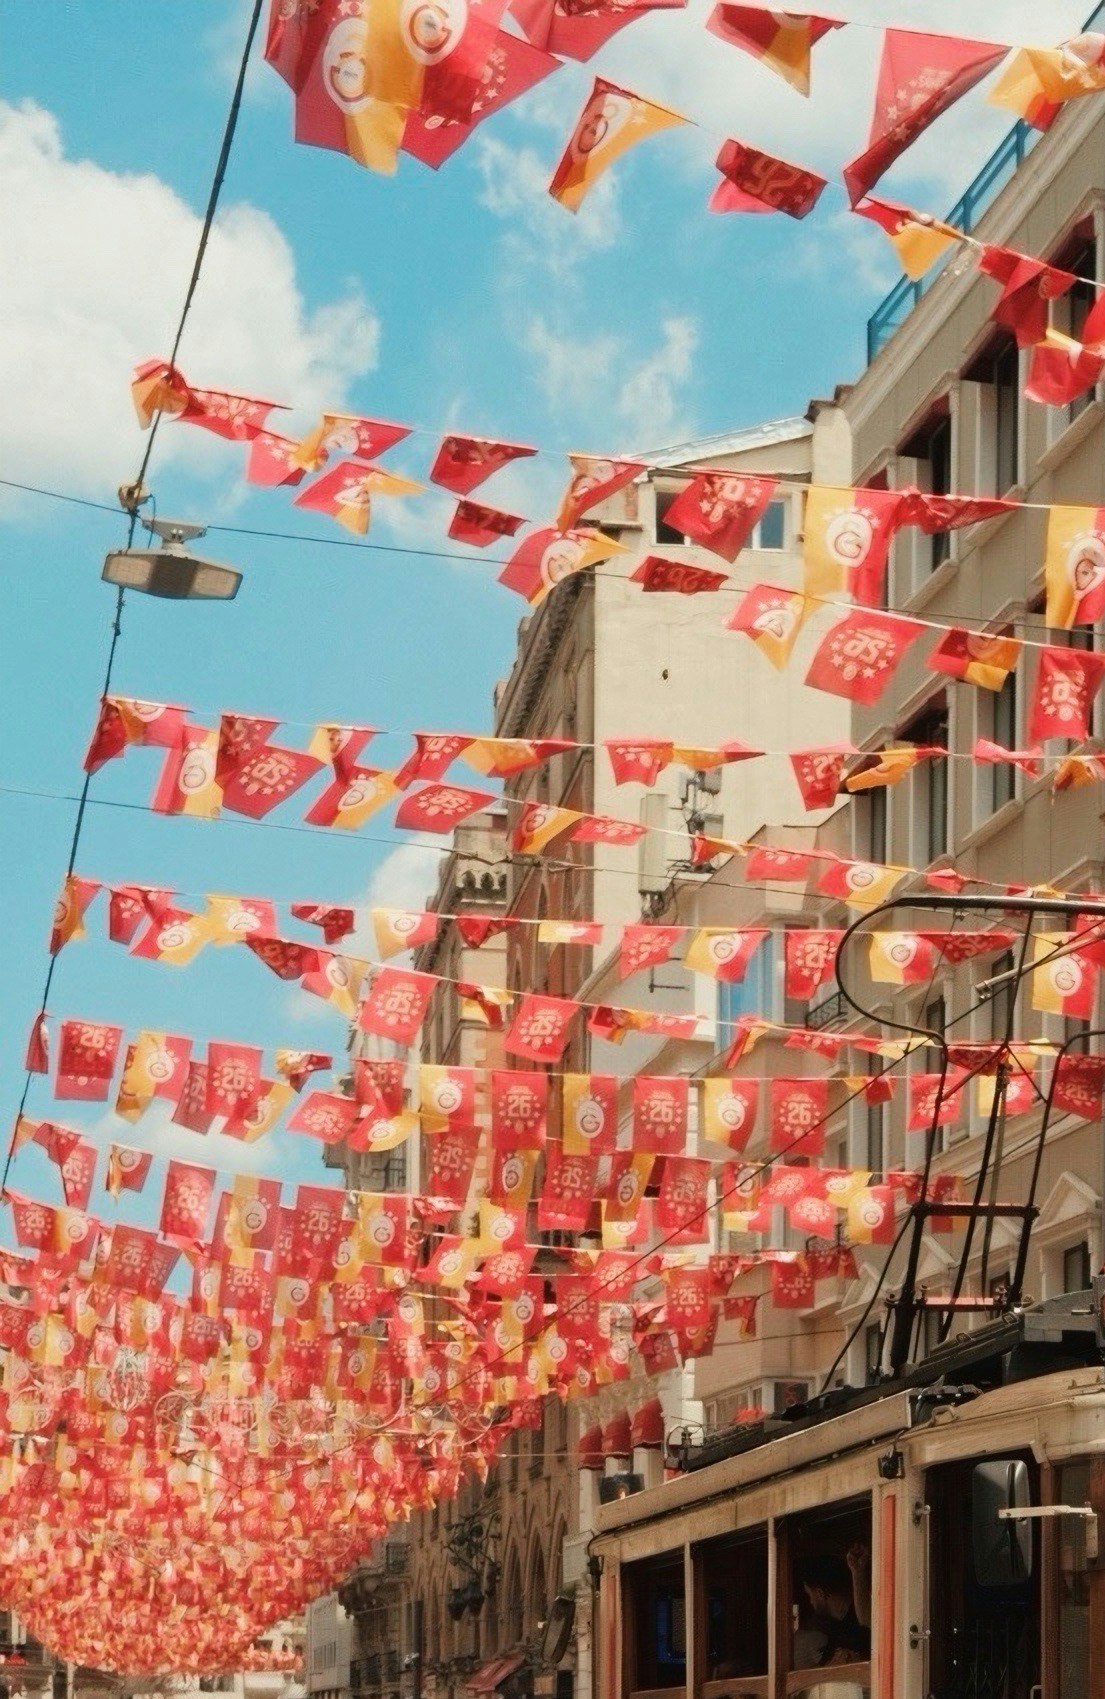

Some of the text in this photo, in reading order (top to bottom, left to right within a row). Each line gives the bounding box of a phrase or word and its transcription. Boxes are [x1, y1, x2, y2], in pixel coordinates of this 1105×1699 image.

[222, 1067, 243, 1089] 26
[508, 1097, 530, 1117] 26
[649, 1100, 673, 1120] 26
[789, 1103, 811, 1124] 26
[309, 1212, 329, 1231] 26
